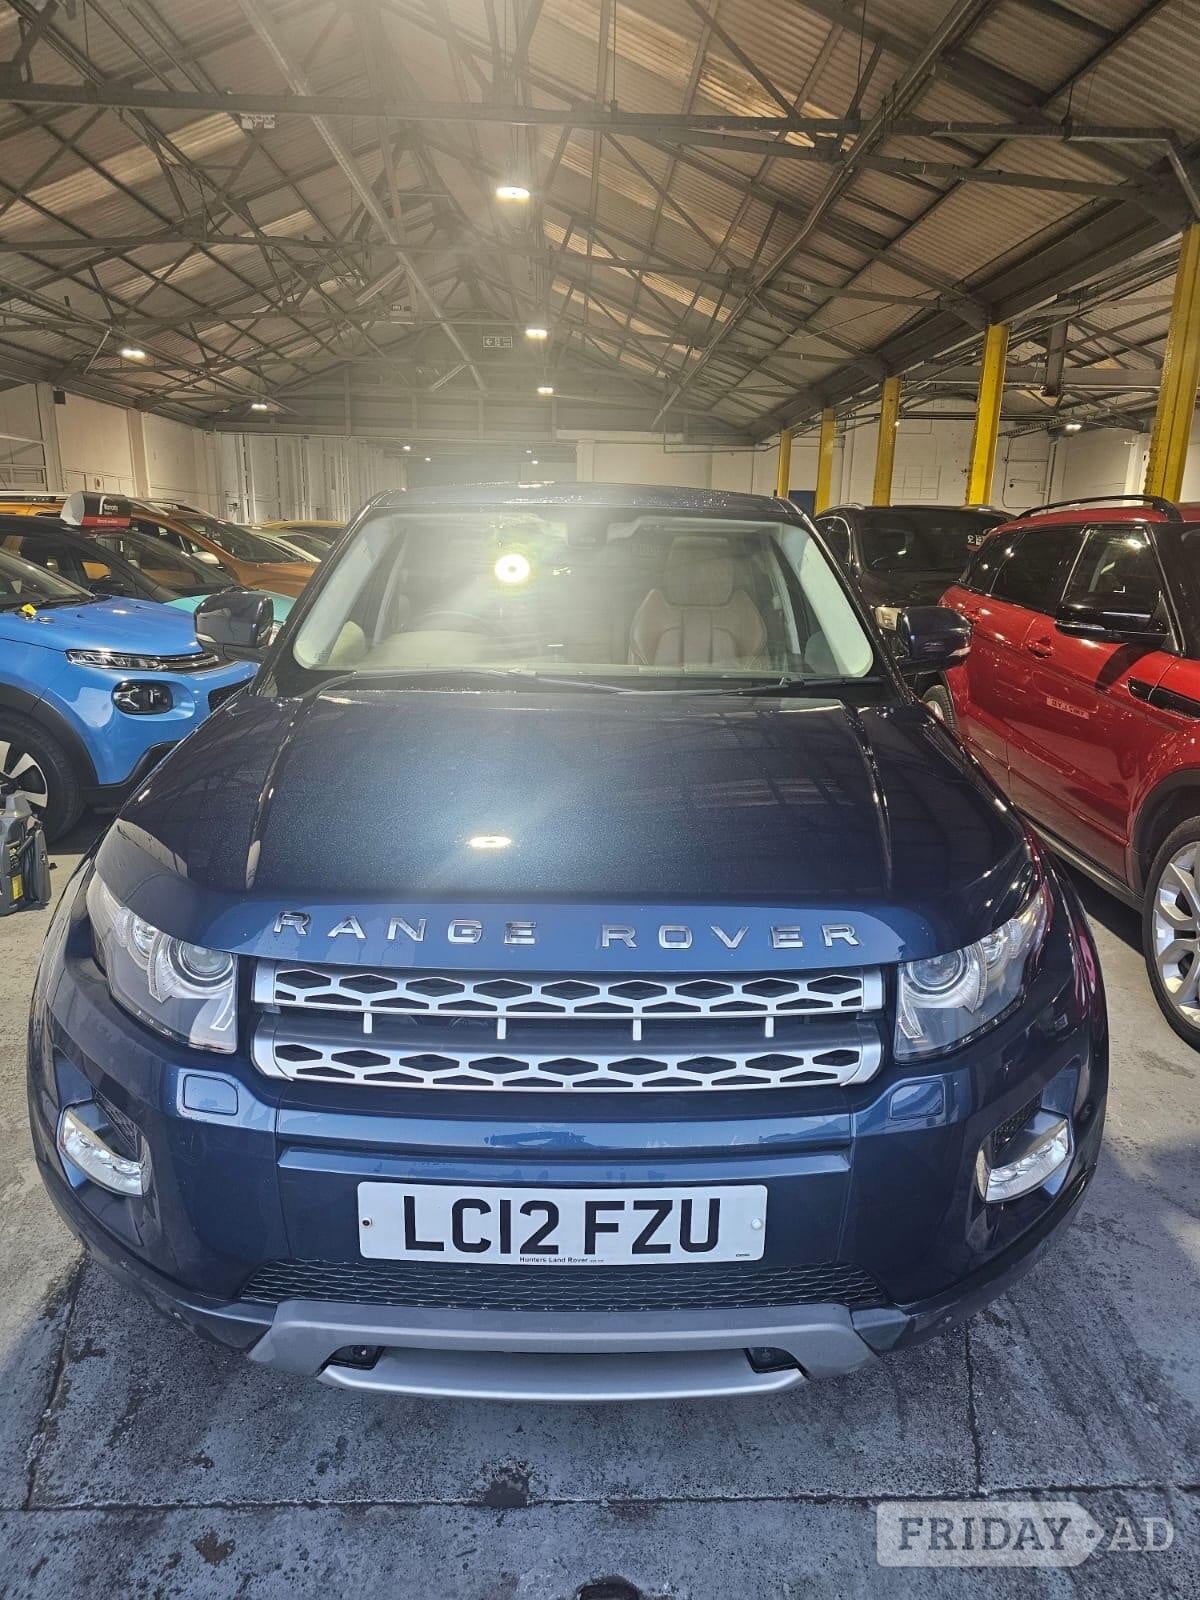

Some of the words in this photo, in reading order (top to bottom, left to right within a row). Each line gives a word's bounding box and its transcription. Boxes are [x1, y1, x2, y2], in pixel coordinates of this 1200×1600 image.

[273, 910, 537, 947] RANGE
[601, 922, 861, 950] ROVER
[403, 1195, 560, 1255] LC12
[584, 1197, 721, 1255] FZU
[519, 1256, 546, 1264] Hunters
[548, 1256, 566, 1264] Land
[568, 1256, 588, 1264] Rover
